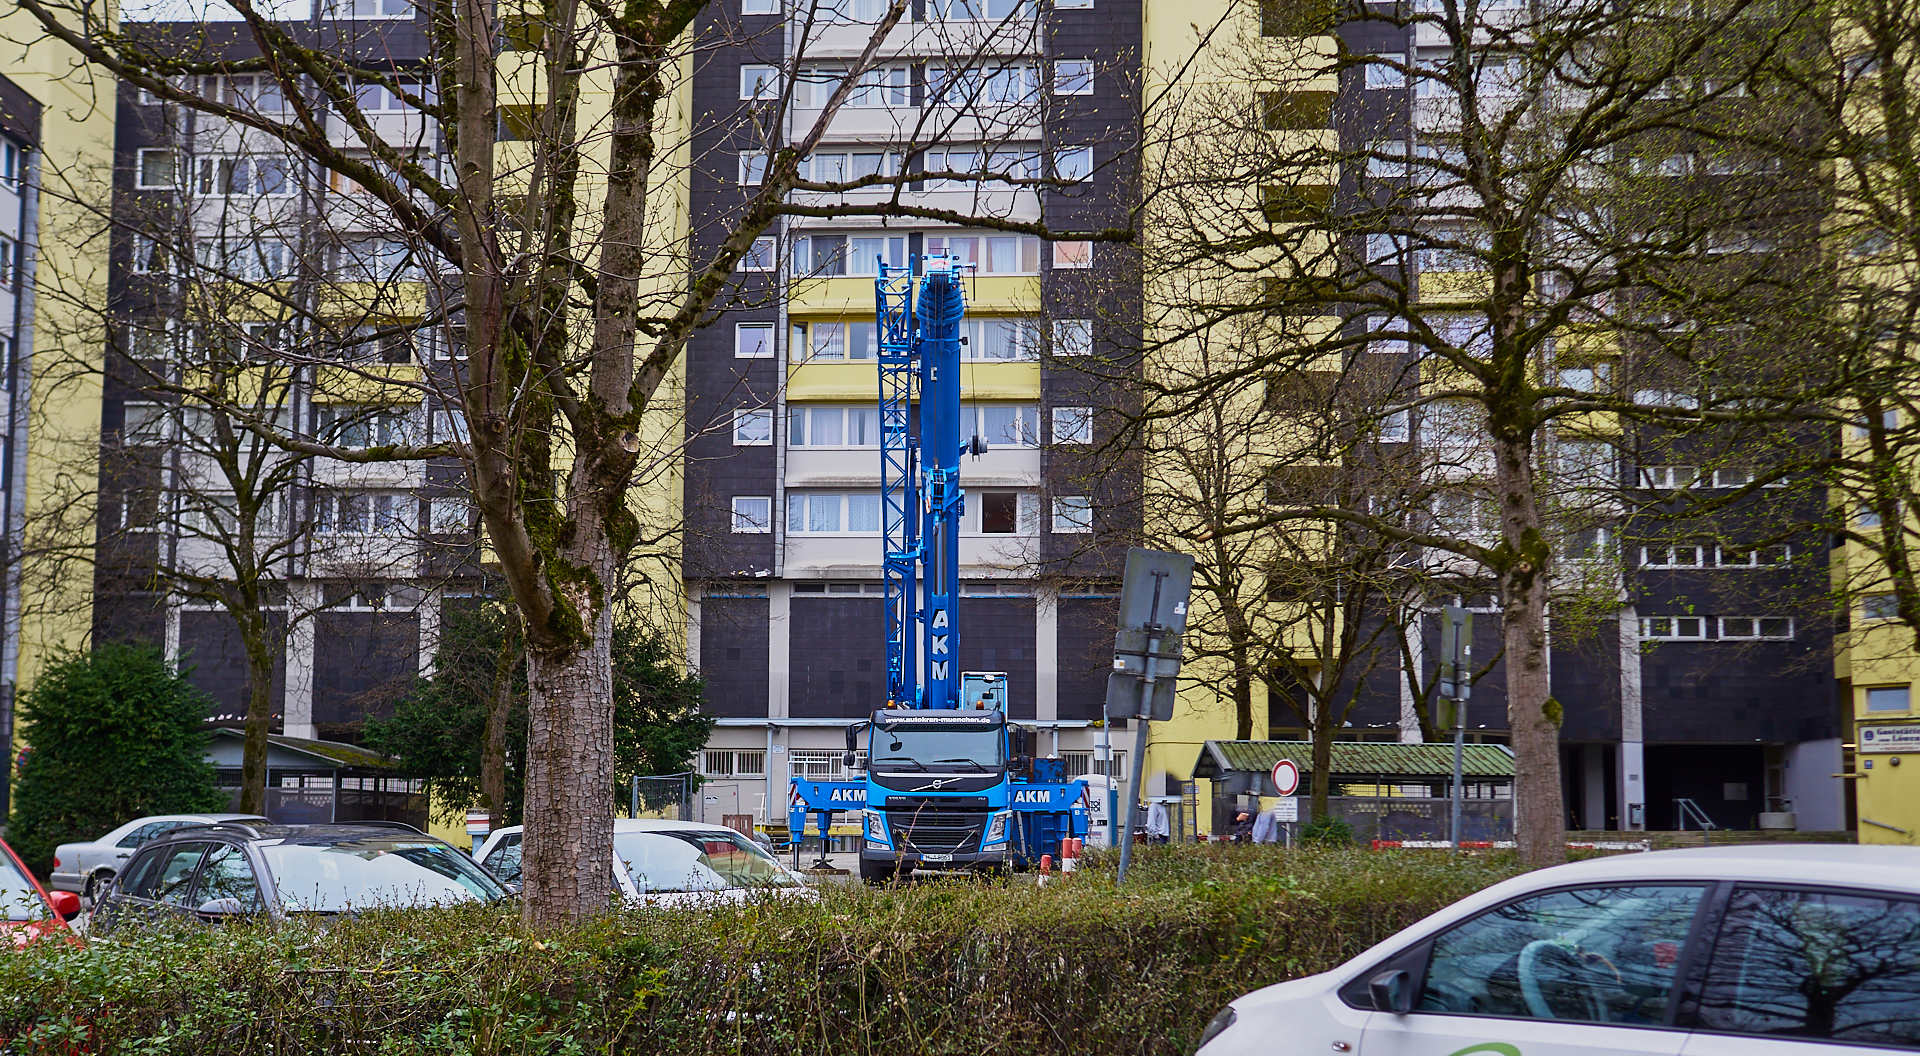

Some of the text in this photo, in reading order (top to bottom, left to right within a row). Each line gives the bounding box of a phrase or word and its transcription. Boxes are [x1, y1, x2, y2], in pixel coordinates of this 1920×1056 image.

[932, 609, 948, 680] AKM
[885, 716, 991, 724] www.autokran-muenchen.de
[831, 788, 866, 802] AKM
[1014, 790, 1050, 803] AKM
